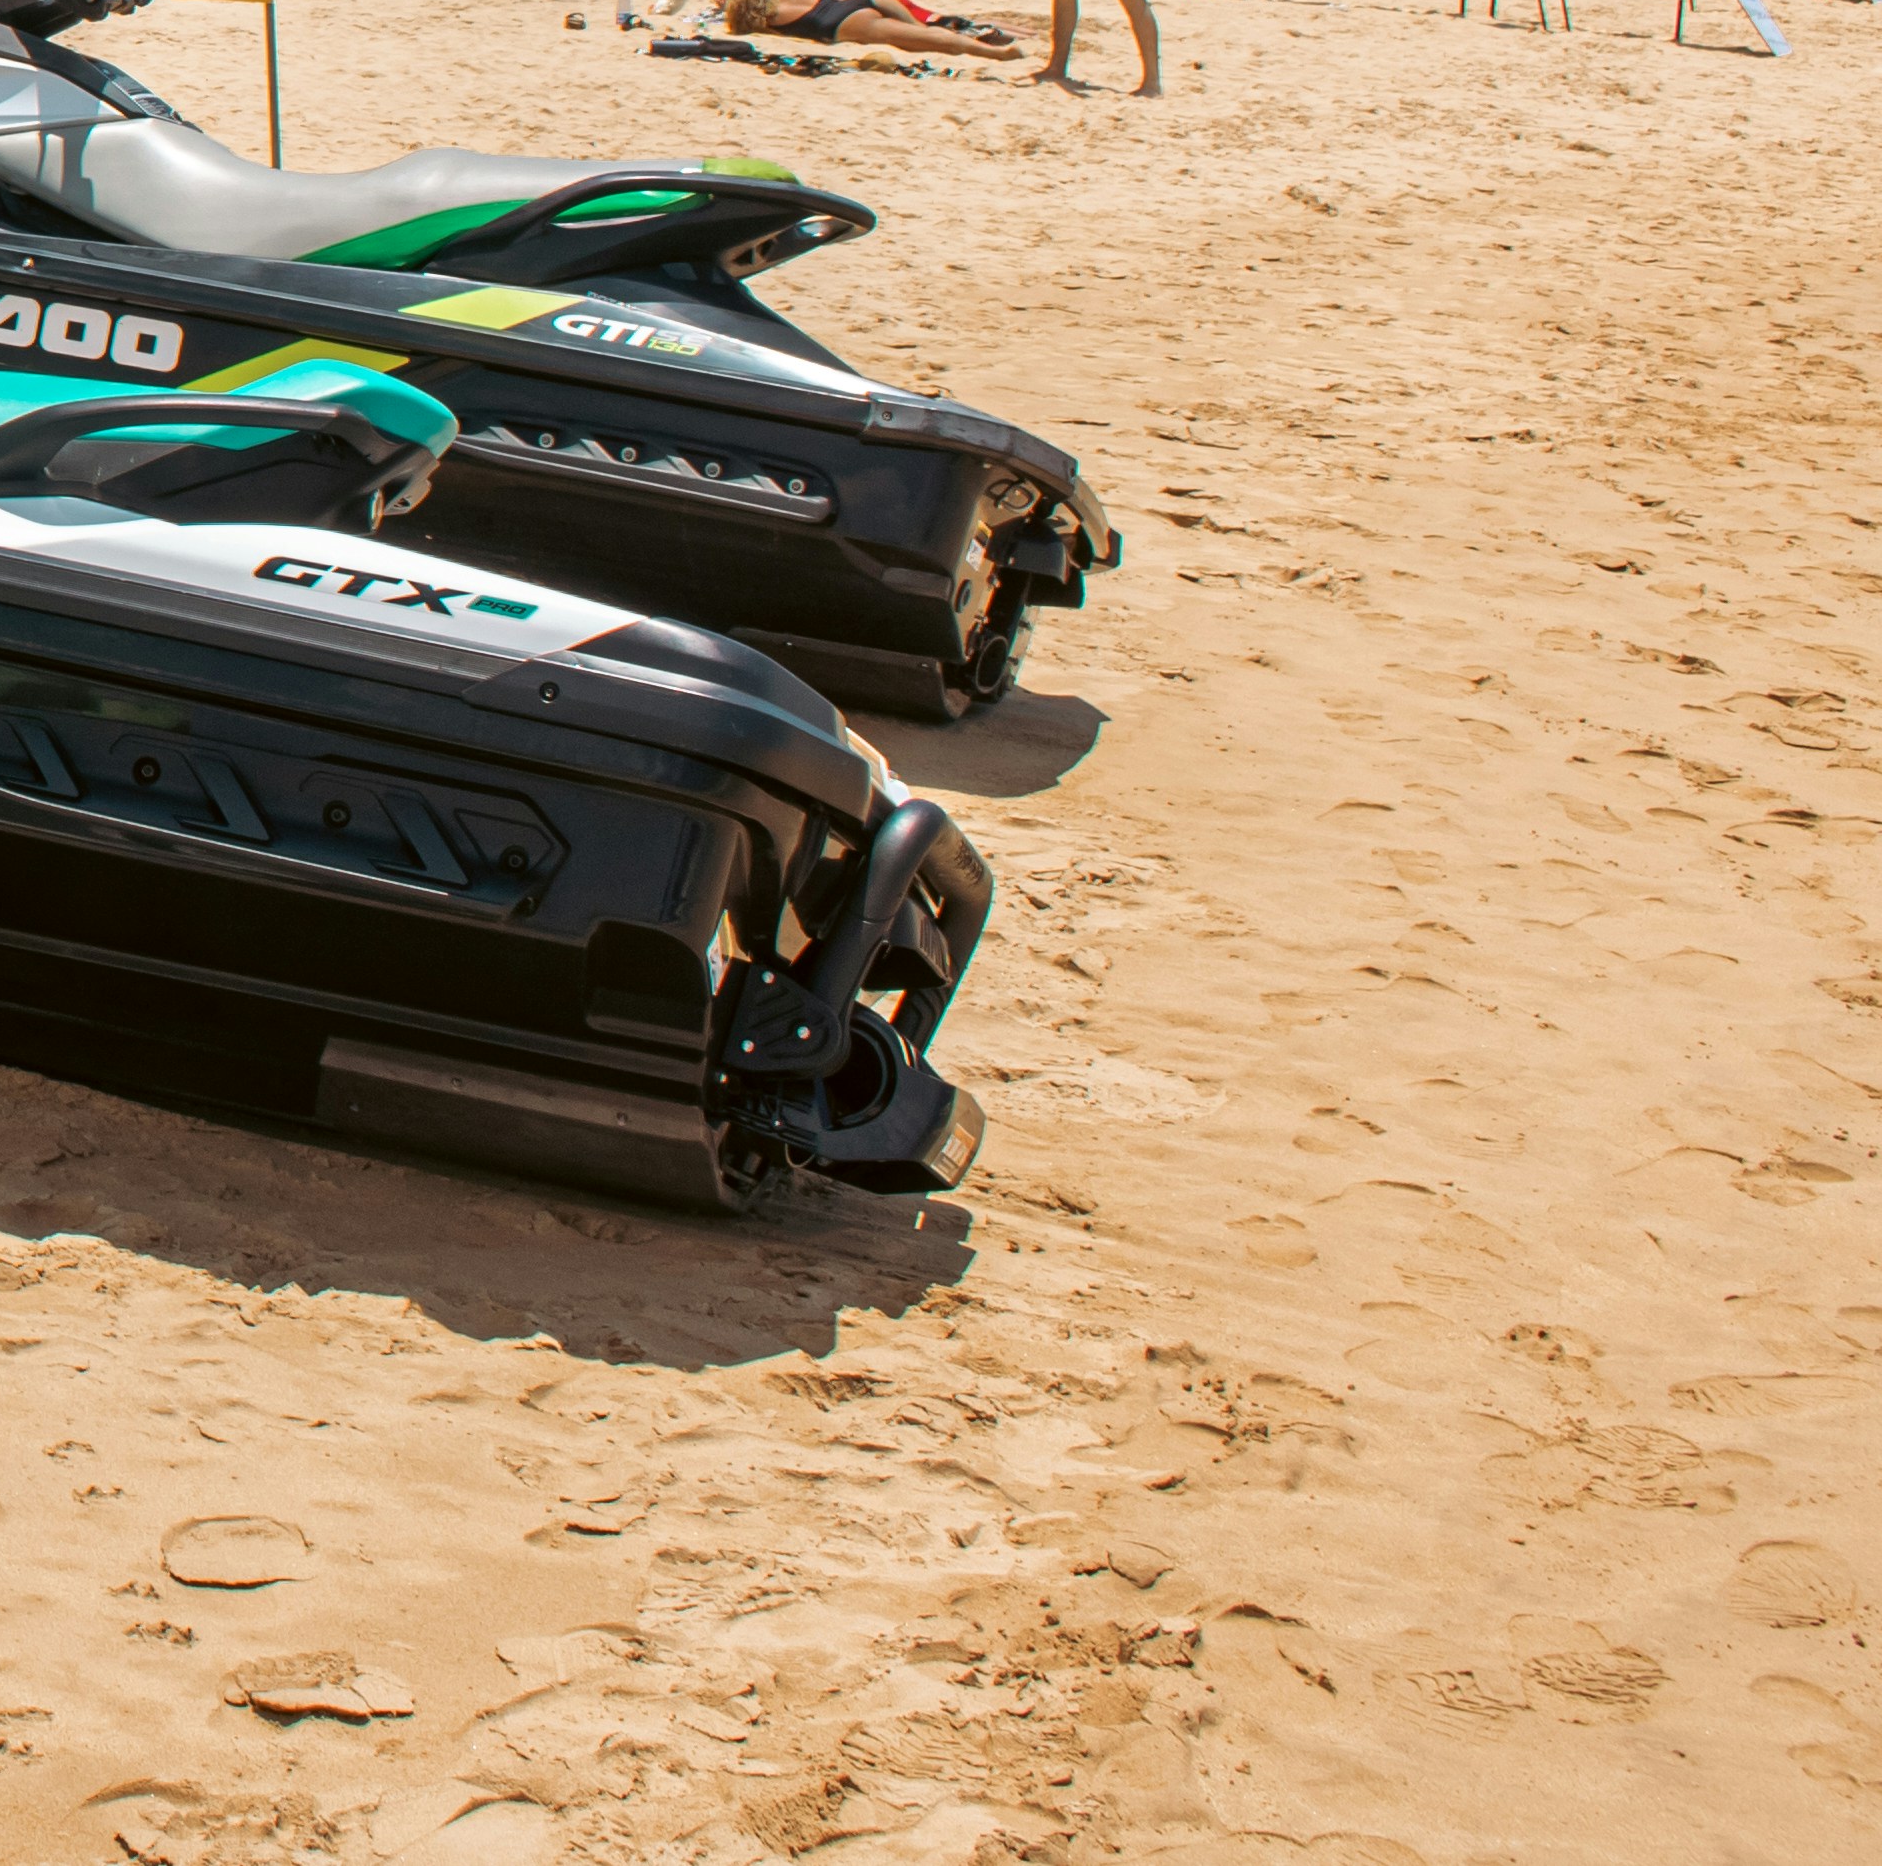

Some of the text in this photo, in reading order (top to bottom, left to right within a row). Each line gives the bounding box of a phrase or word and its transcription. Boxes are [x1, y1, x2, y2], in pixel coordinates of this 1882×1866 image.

[553, 314, 656, 347] GTI
[648, 338, 702, 356] 130
[252, 556, 473, 616] GTX
[475, 599, 527, 615] PRO
